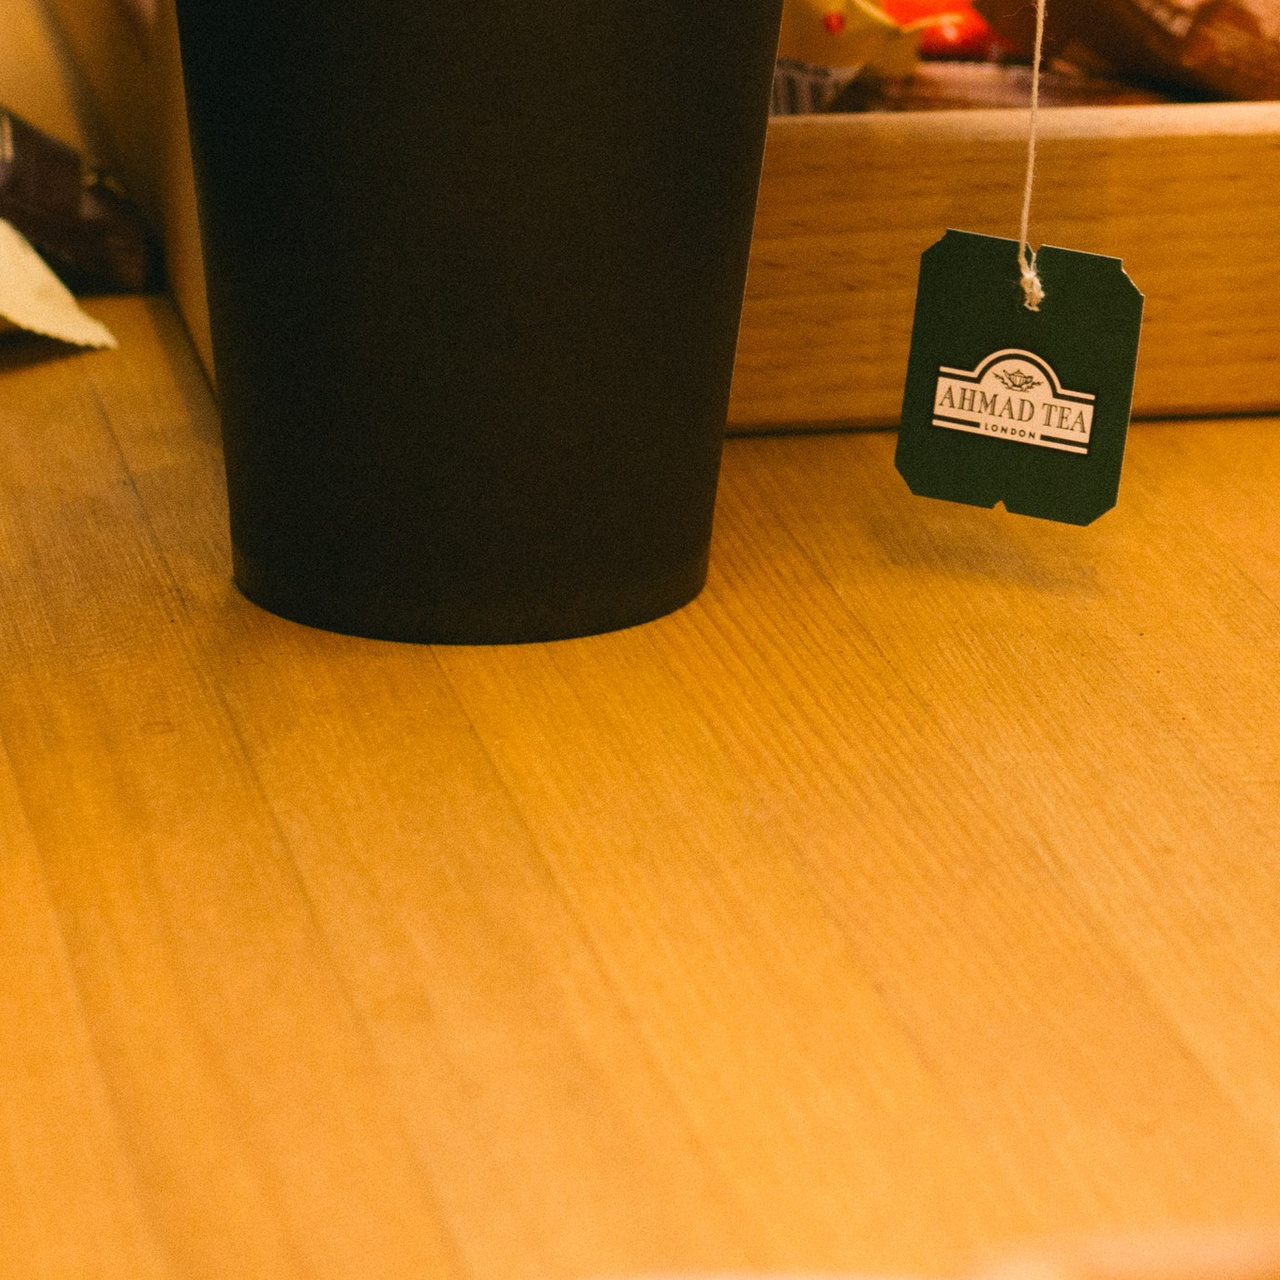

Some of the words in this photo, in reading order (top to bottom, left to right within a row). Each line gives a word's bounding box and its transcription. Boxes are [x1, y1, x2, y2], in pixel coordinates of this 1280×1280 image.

[938, 386, 1035, 422] AHMAD
[1041, 402, 1088, 434] TEA
[984, 422, 1036, 440] LONDON
